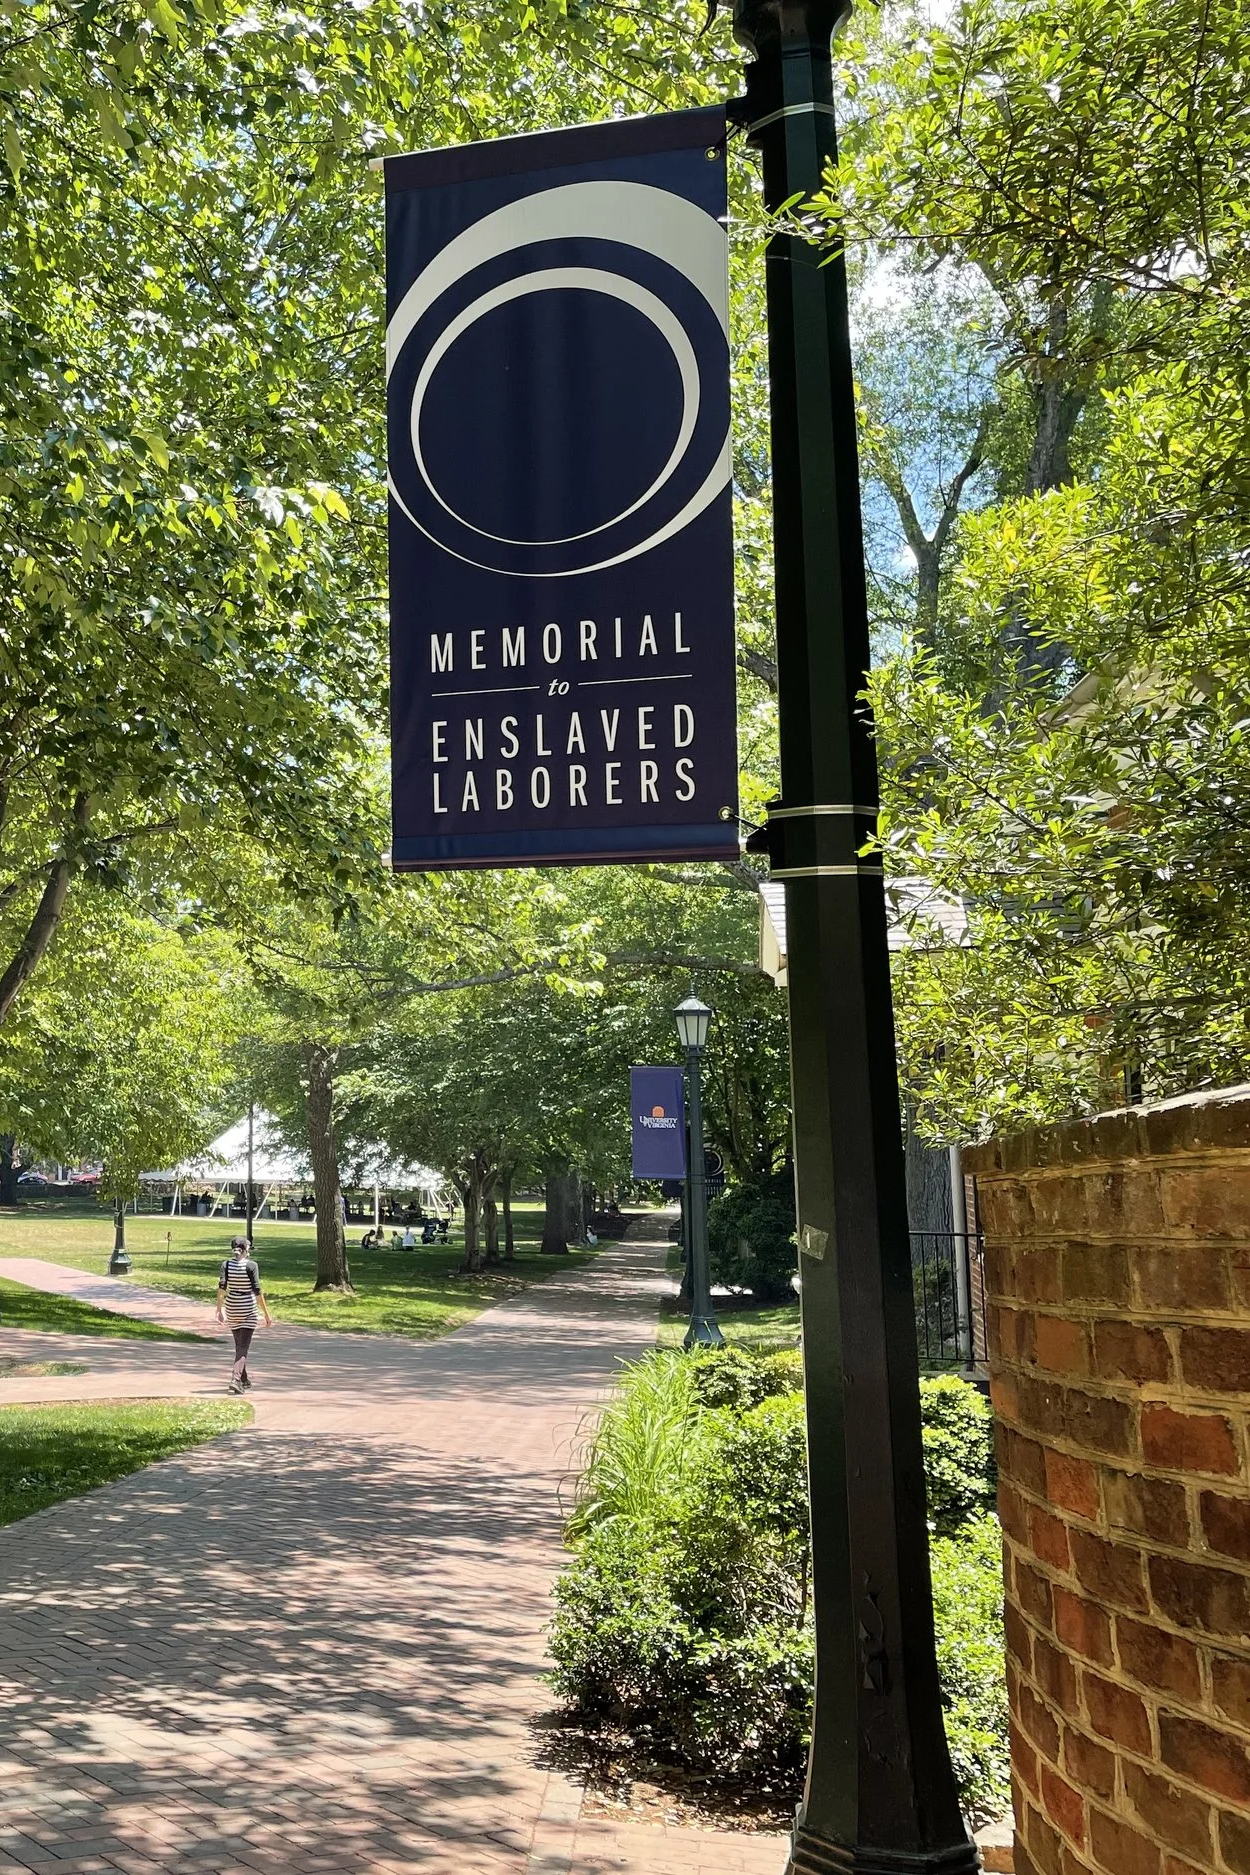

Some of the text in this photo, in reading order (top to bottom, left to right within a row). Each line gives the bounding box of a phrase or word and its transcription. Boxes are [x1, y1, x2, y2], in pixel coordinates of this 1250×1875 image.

[430, 612, 691, 673] MEMORIAL
[547, 678, 570, 697] to
[432, 704, 696, 763] ENSLAVED
[433, 757, 697, 814] LABORERS
